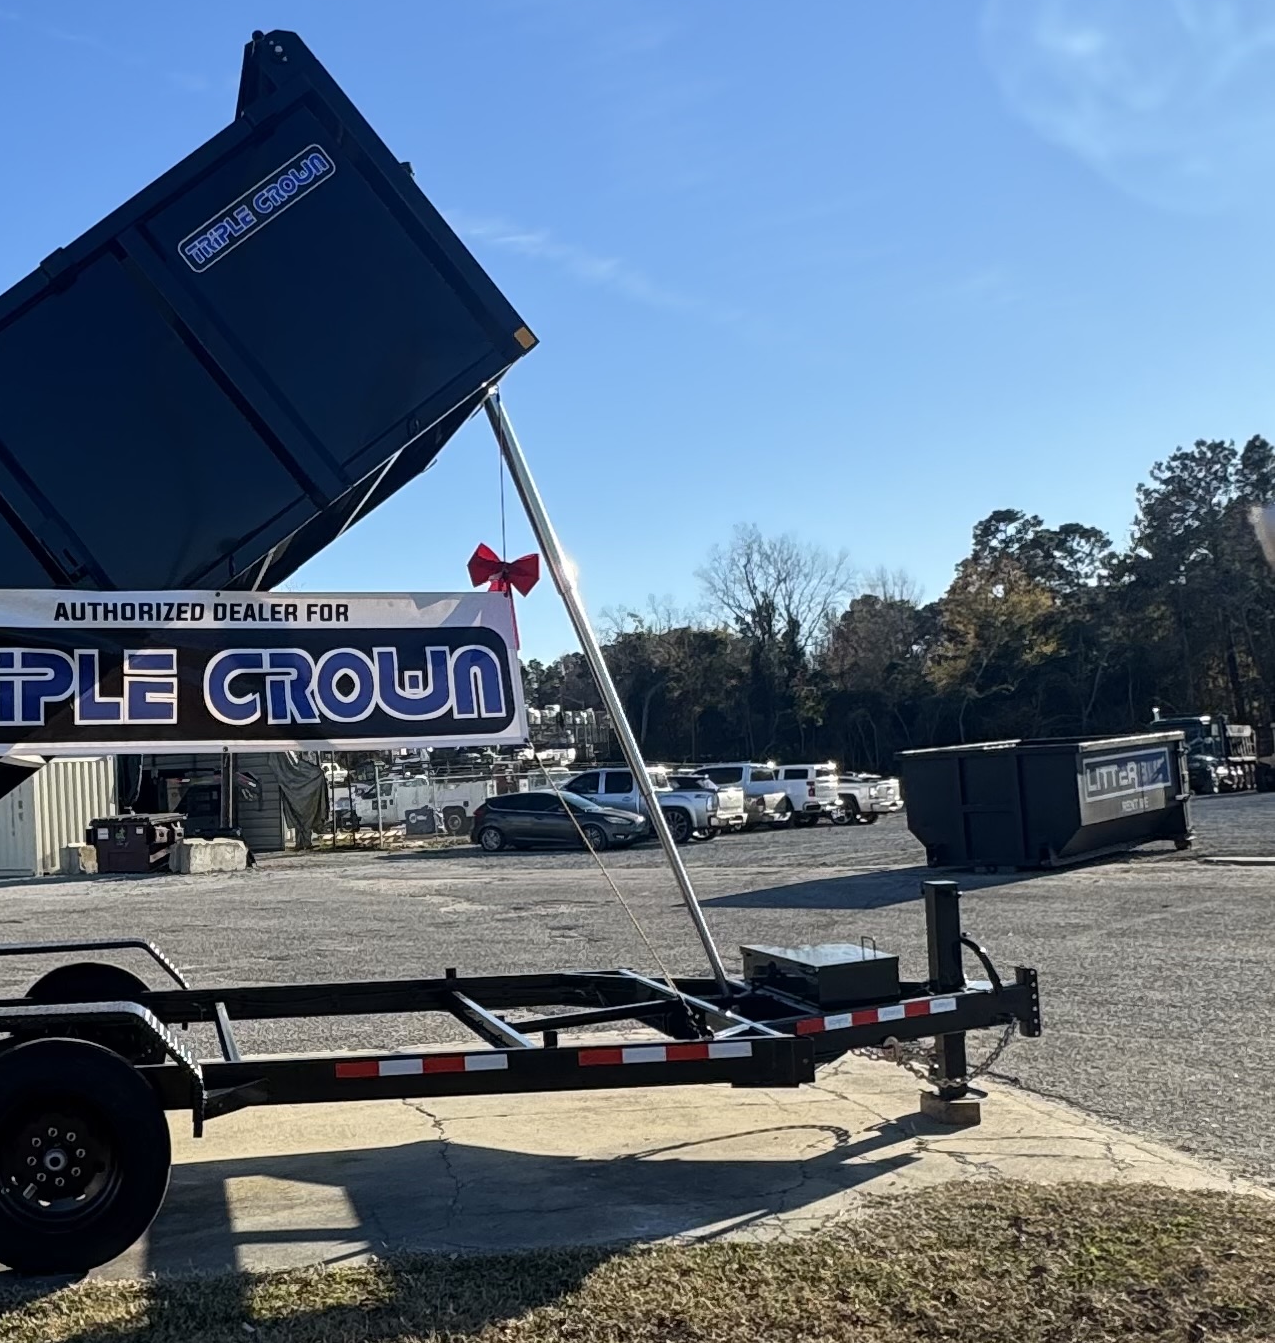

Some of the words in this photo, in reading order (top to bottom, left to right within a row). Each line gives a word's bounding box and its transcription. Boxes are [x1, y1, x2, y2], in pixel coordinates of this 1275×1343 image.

[185, 205, 257, 264] TRIPLE
[253, 153, 330, 214] CROWN
[53, 602, 205, 622] AUTHORIZED
[213, 603, 298, 622] DEALER
[306, 603, 349, 622] FOR
[203, 645, 507, 726] CROWN
